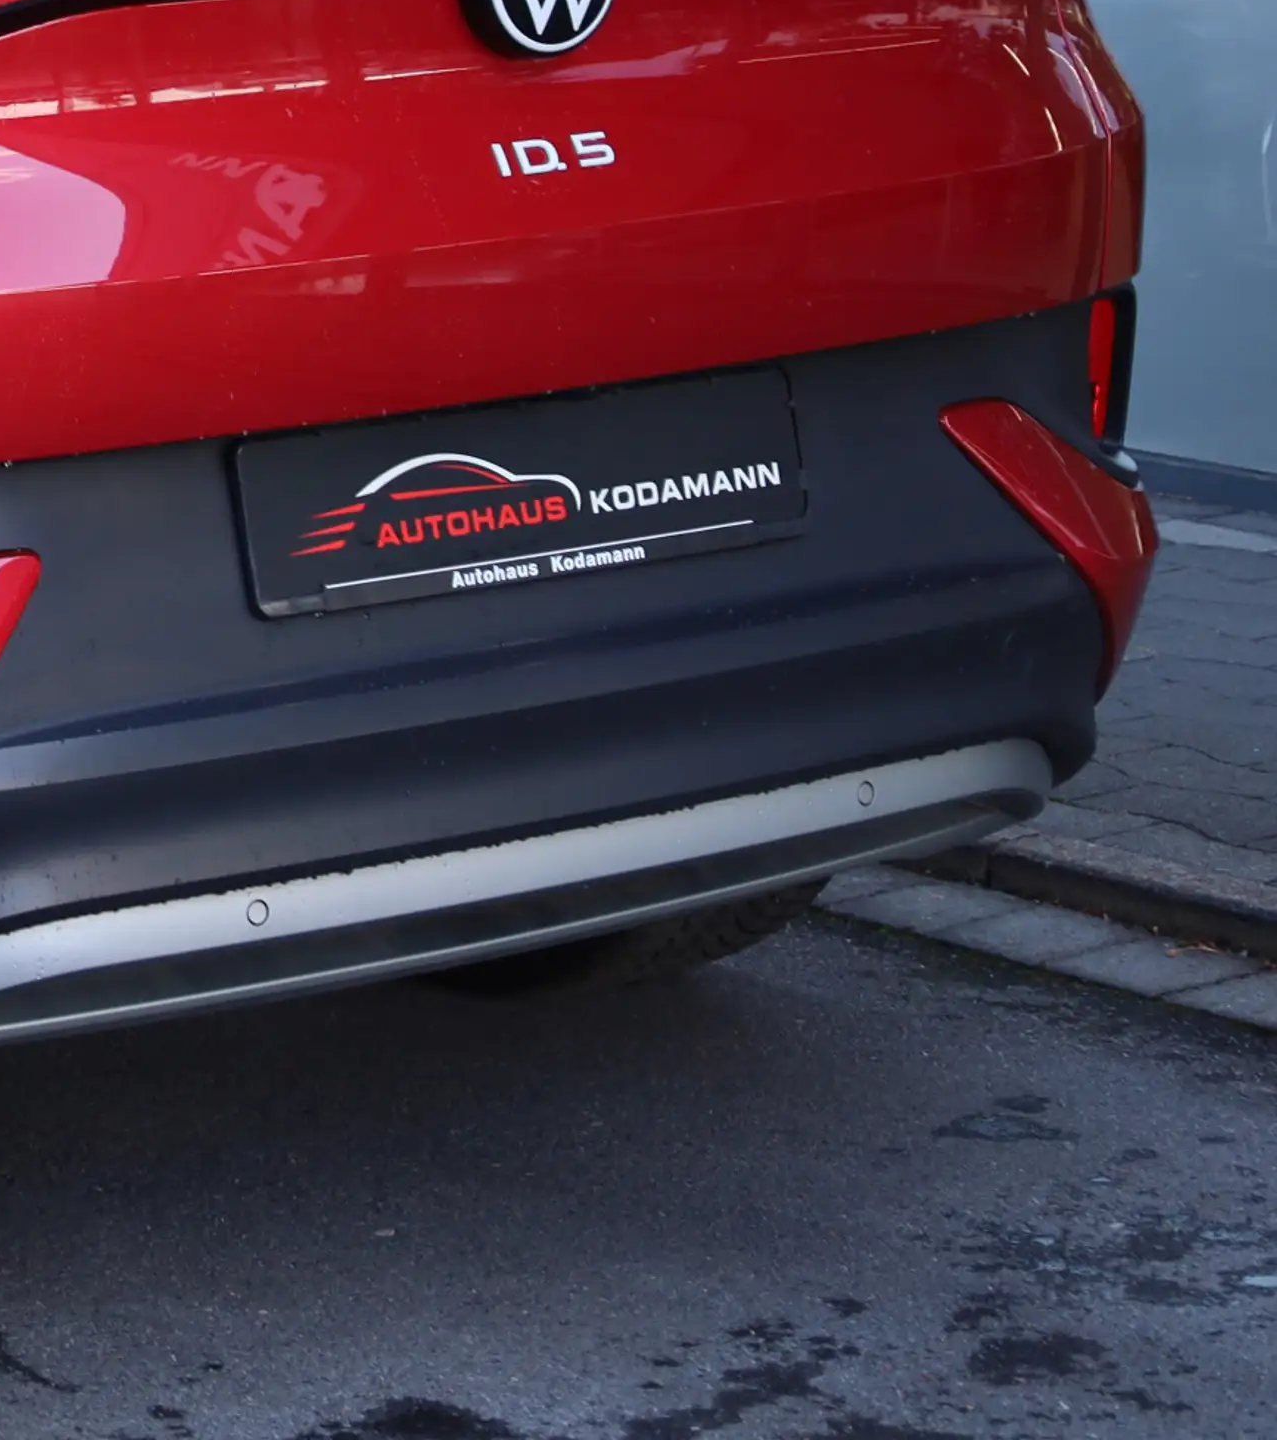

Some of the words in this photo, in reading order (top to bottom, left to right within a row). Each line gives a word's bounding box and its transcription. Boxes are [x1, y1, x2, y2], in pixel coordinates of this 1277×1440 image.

[376, 496, 568, 548] AUTOHAUS
[589, 462, 782, 515] KODAMANN
[451, 560, 539, 589] Autohaus
[550, 543, 646, 573] Kodamann
